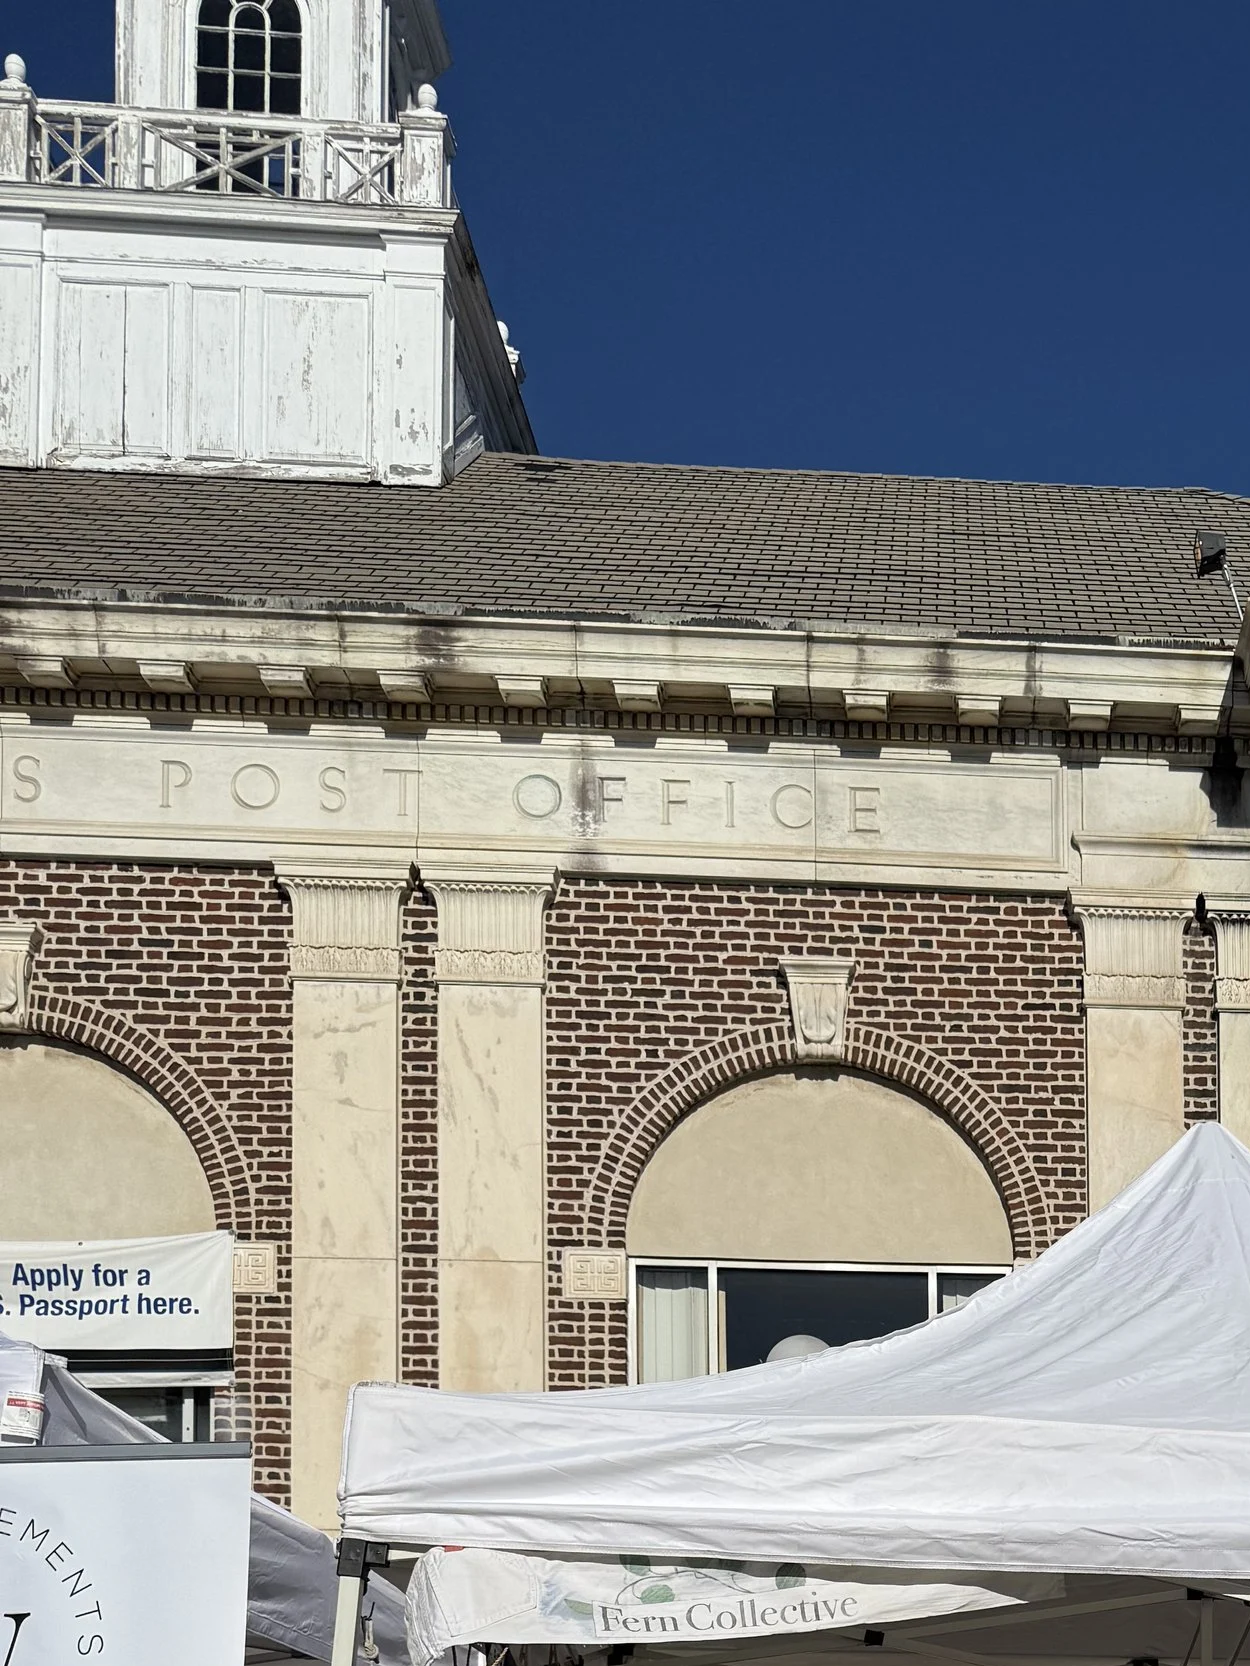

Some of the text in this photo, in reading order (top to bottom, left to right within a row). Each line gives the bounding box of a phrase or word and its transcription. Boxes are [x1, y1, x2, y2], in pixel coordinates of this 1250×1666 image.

[160, 759, 423, 818] POST
[512, 774, 881, 833] OFFICE
[12, 1263, 150, 1291] Apply for a
[20, 1294, 129, 1320] Passport
[137, 1293, 200, 1315] here.
[599, 1591, 859, 1634] Fern Collective
